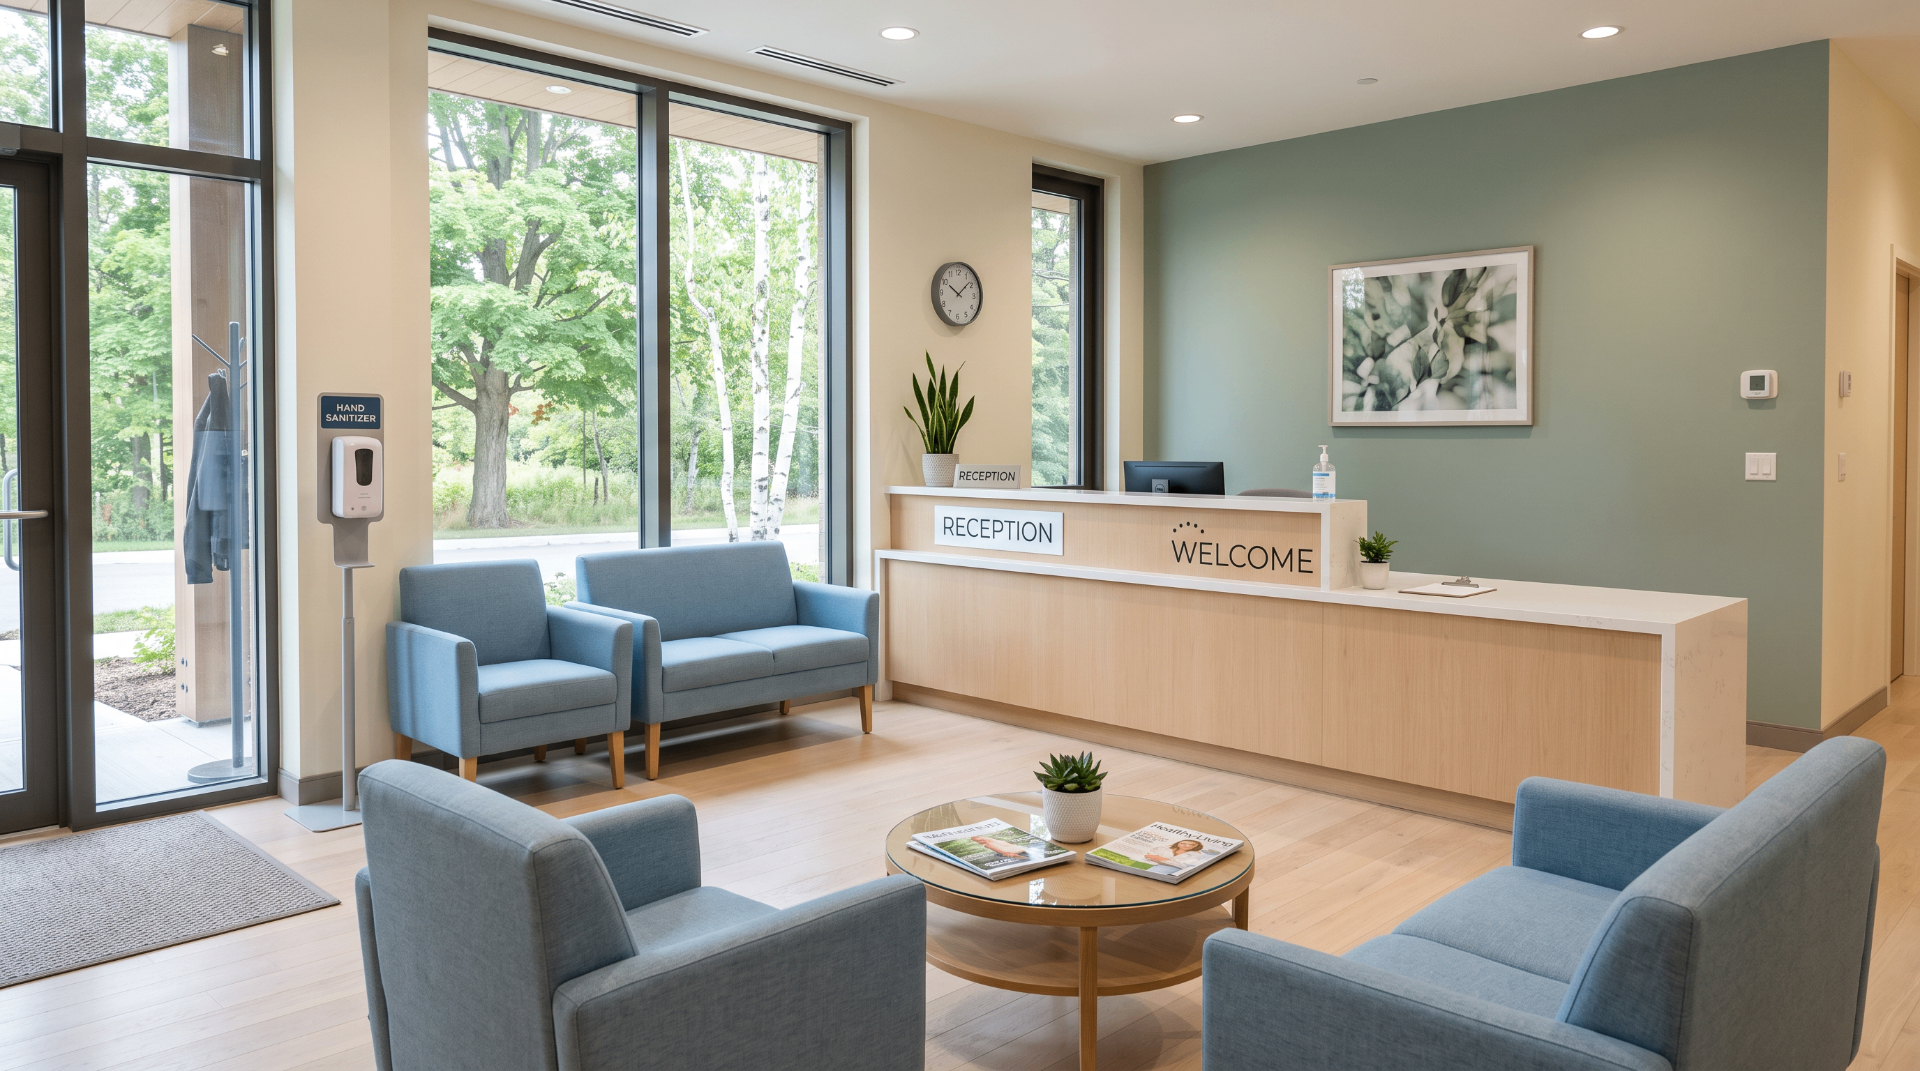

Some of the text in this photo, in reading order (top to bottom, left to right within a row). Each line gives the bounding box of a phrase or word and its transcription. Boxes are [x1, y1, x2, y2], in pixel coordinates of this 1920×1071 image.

[336, 403, 365, 412] HAND
[325, 413, 377, 423] SANITIZER
[958, 470, 1016, 482] RECEPTION
[943, 516, 1052, 544] RECEPTION
[1171, 540, 1314, 574] WELCOME
